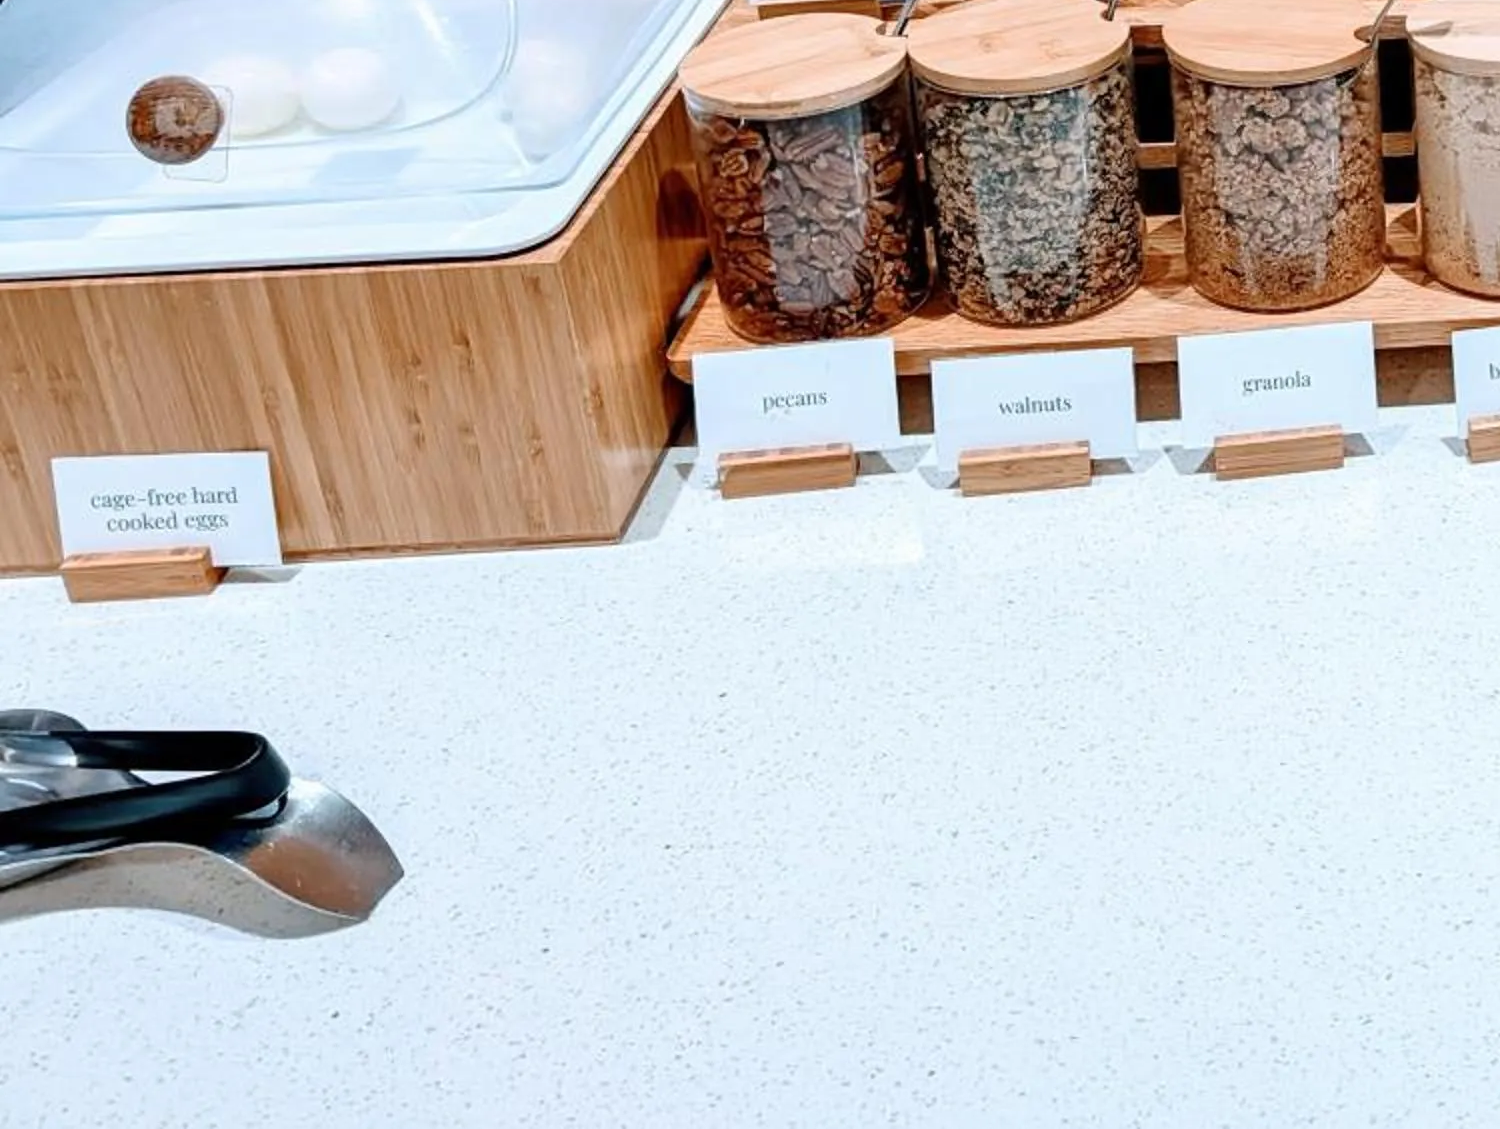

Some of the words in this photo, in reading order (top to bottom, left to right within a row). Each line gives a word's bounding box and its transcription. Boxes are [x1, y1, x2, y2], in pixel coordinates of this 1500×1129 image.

[1242, 371, 1312, 395] granola
[762, 389, 828, 413] pecans
[998, 396, 1073, 415] walnuts
[90, 488, 187, 511] cage-free
[192, 486, 238, 504] hard
[107, 511, 178, 532] cooked
[184, 514, 229, 532] eggs
